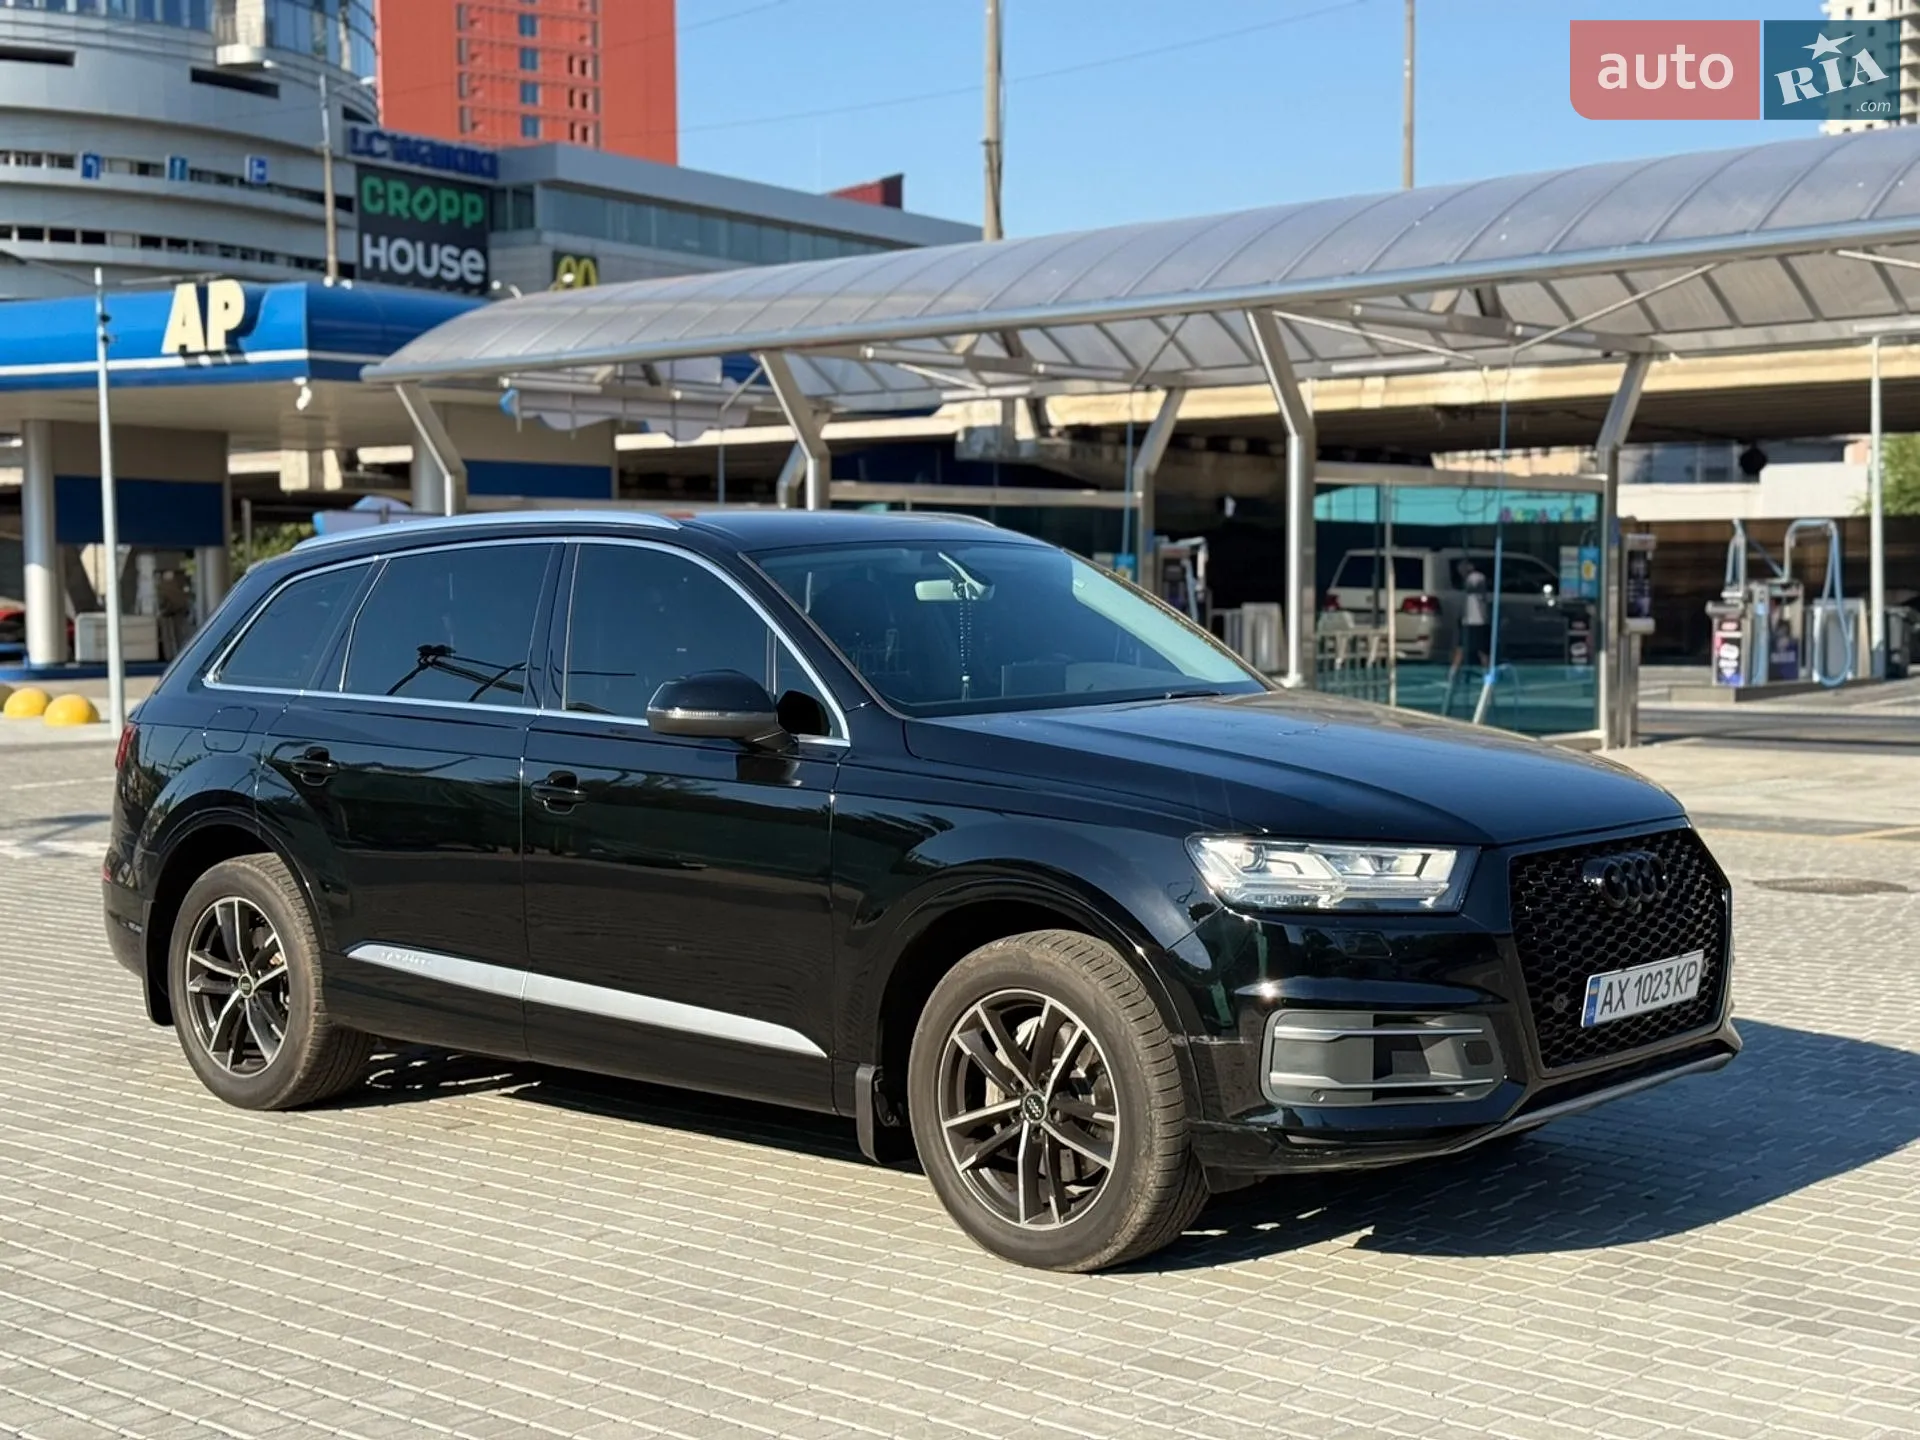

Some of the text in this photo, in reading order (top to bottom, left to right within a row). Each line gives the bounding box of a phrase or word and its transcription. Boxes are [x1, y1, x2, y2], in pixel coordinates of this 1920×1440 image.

[361, 175, 484, 228] CROPP
[161, 279, 245, 354] AP
[1599, 978, 1631, 1016] AX
